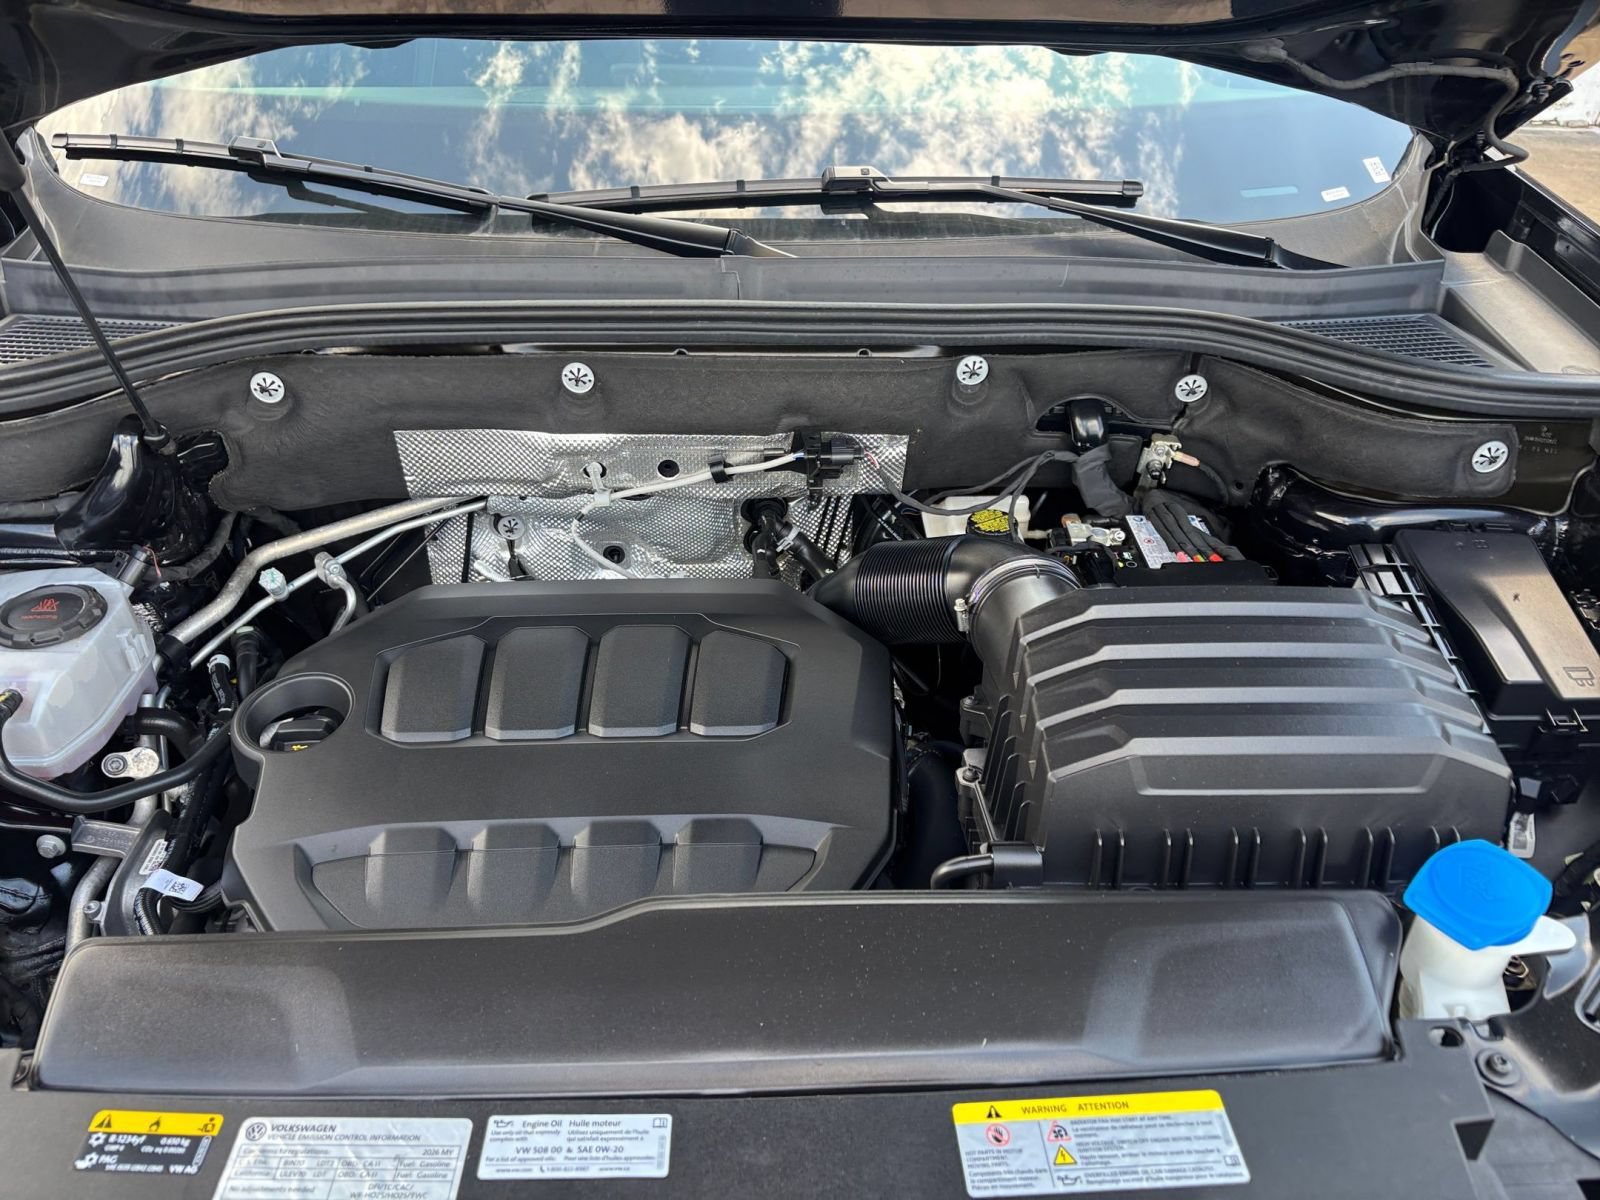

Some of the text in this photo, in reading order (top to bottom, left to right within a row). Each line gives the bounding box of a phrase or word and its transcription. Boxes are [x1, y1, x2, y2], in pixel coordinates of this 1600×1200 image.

[1022, 1101, 1130, 1115] WARNING ATTENTION
[271, 1124, 337, 1132] VOLKSWAGEN
[522, 1120, 549, 1130] Engine
[592, 1120, 621, 1128] moteur
[516, 1146, 532, 1154] VW
[532, 1146, 548, 1154] 508
[577, 1145, 593, 1154] SAE
[594, 1145, 624, 1154] 0W-20
[98, 1154, 119, 1164] PAG
[169, 1164, 186, 1174] VW
[184, 1165, 198, 1174] AG
